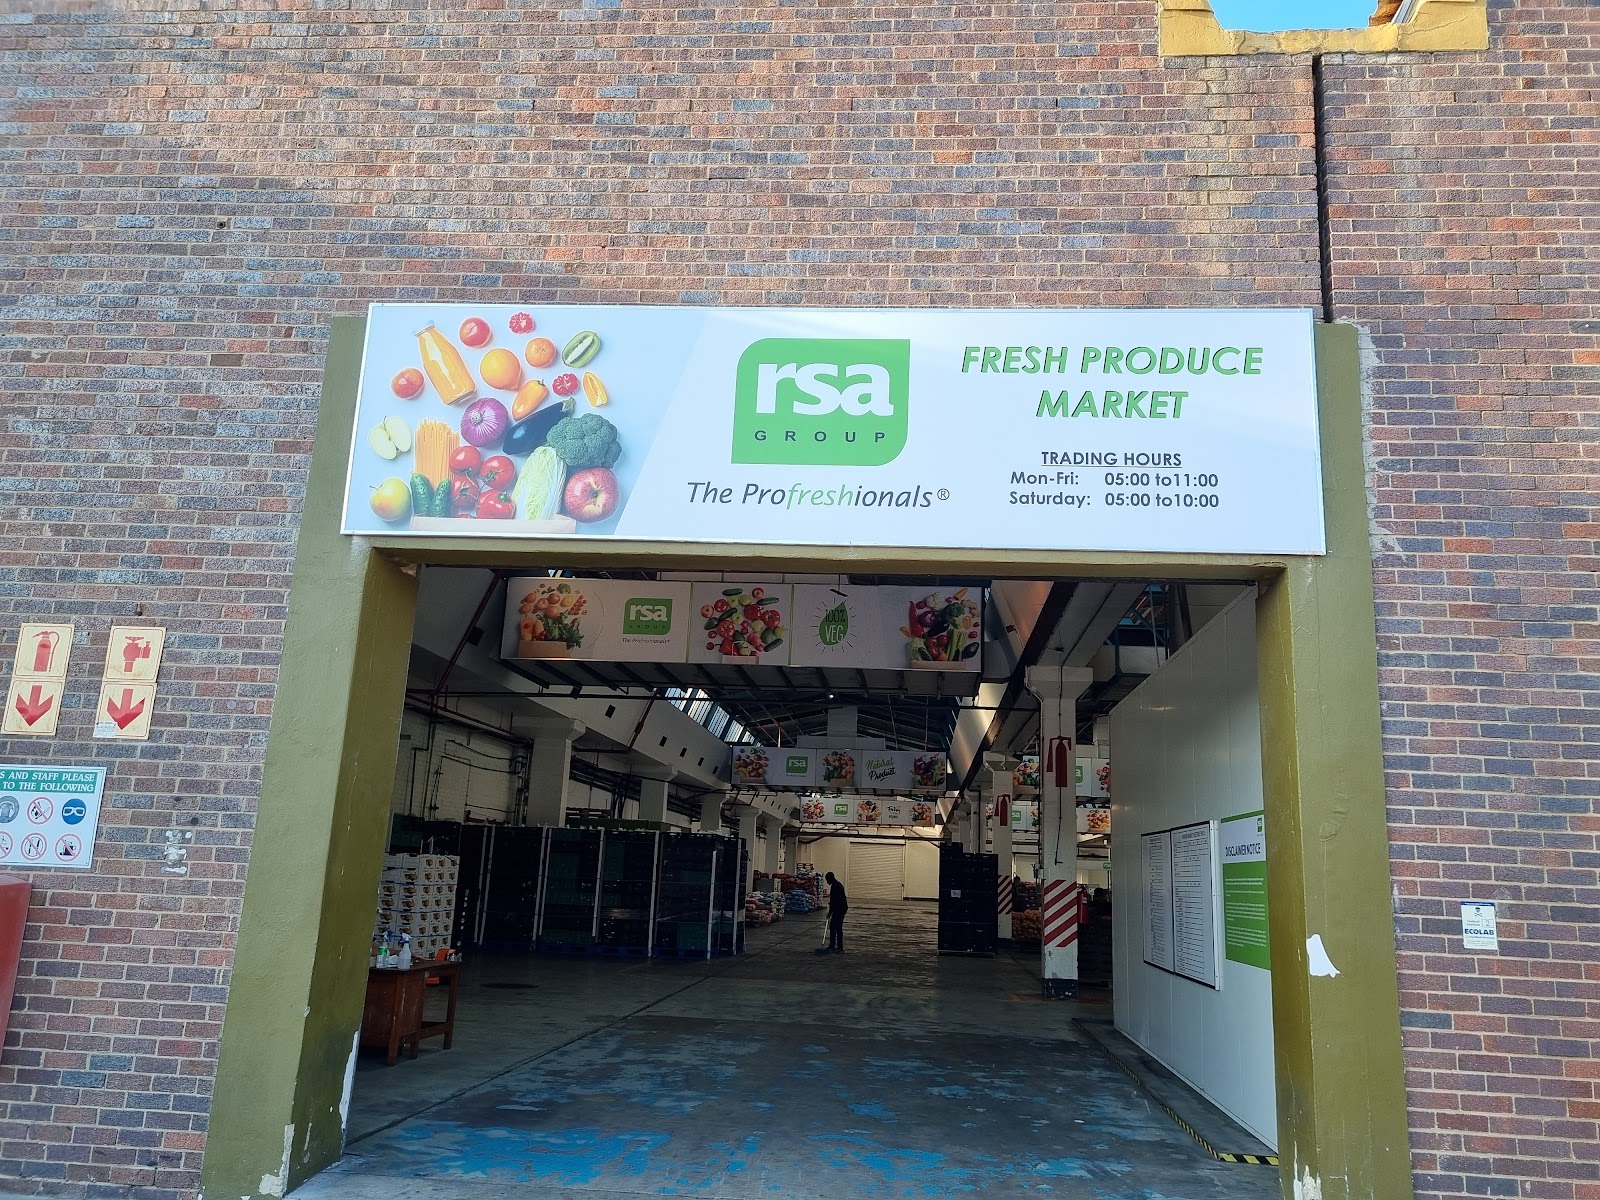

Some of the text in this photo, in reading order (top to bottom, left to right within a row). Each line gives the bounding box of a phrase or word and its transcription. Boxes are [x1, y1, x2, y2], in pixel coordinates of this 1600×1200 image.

[961, 345, 1264, 376] FRESH PRODUCE
[755, 362, 894, 417] rsa
[1035, 389, 1190, 419] MARKET
[754, 430, 886, 443] GROUP
[1041, 451, 1183, 467] TRADING HOURS
[1010, 471, 1080, 486] Mon-Fri:
[1104, 472, 1151, 487] 05:00
[687, 481, 733, 504] The
[1009, 491, 1092, 509] Saturday:
[1104, 492, 1151, 507] 05:00
[629, 605, 667, 622] rsa
[825, 624, 844, 643] VEG
[788, 758, 806, 768] rsa
[865, 756, 894, 771] Natural
[8, 771, 29, 780] AND
[32, 772, 59, 781] STAFF
[61, 773, 95, 782] PLEASE
[868, 767, 896, 781] Product
[3, 781, 95, 792] TO THE FOLLOWING
[1225, 842, 1261, 857] DISCLAIMER NOTICE
